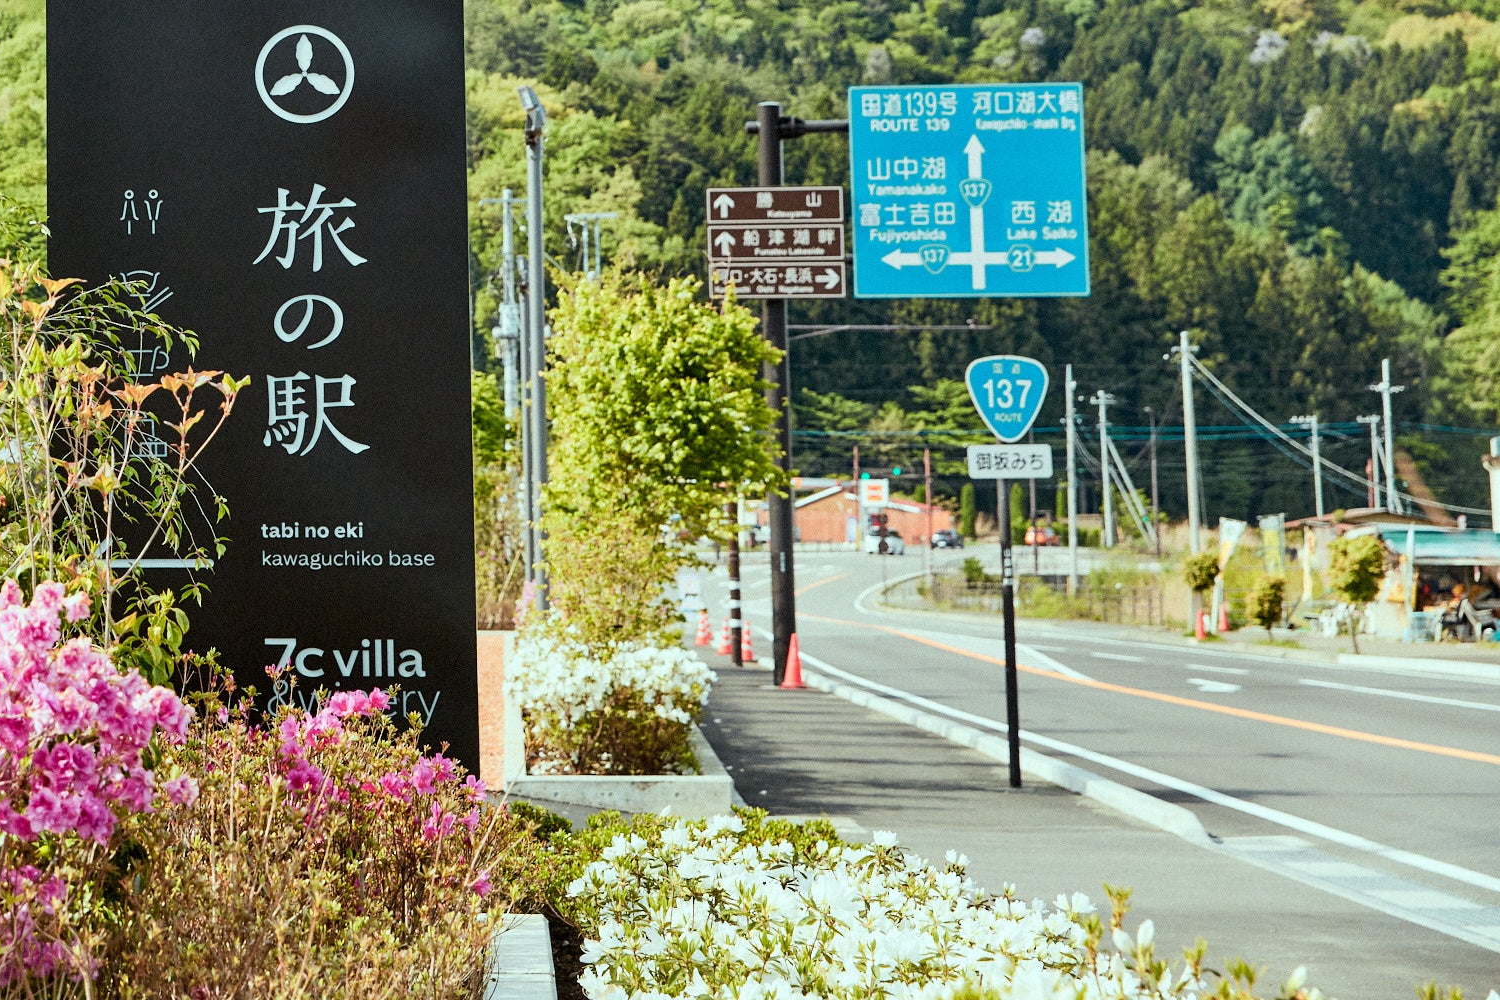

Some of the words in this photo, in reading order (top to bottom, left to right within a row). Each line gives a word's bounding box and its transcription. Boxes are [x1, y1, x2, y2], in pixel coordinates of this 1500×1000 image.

[861, 91, 958, 117] 国道139号
[972, 89, 1079, 116] 河口湖大橋
[870, 118, 919, 132] ROUTE
[925, 118, 951, 132] 139
[867, 154, 947, 181] 山中湖
[867, 183, 948, 197] Yamanakako
[963, 183, 986, 198] 137
[858, 202, 956, 227] 富士吉田
[1010, 200, 1073, 225] 西湖
[869, 229, 948, 244] Fujiyoshida
[1007, 227, 1038, 241] Lake
[1041, 226, 1078, 241] Saiko
[922, 249, 945, 263] 137
[1011, 251, 1032, 267] 21
[252, 182, 371, 457] 旅の駅
[982, 378, 1033, 409] 137
[994, 412, 1023, 422] ROUTE
[976, 451, 1045, 471] 御坂みち
[261, 522, 300, 539] tabi
[304, 525, 330, 539] no
[334, 521, 364, 539] eki
[262, 549, 384, 570] kawaguchiko
[389, 549, 436, 567] base
[264, 637, 325, 678] 7c
[332, 638, 427, 678] villa
[297, 681, 441, 728] wery
